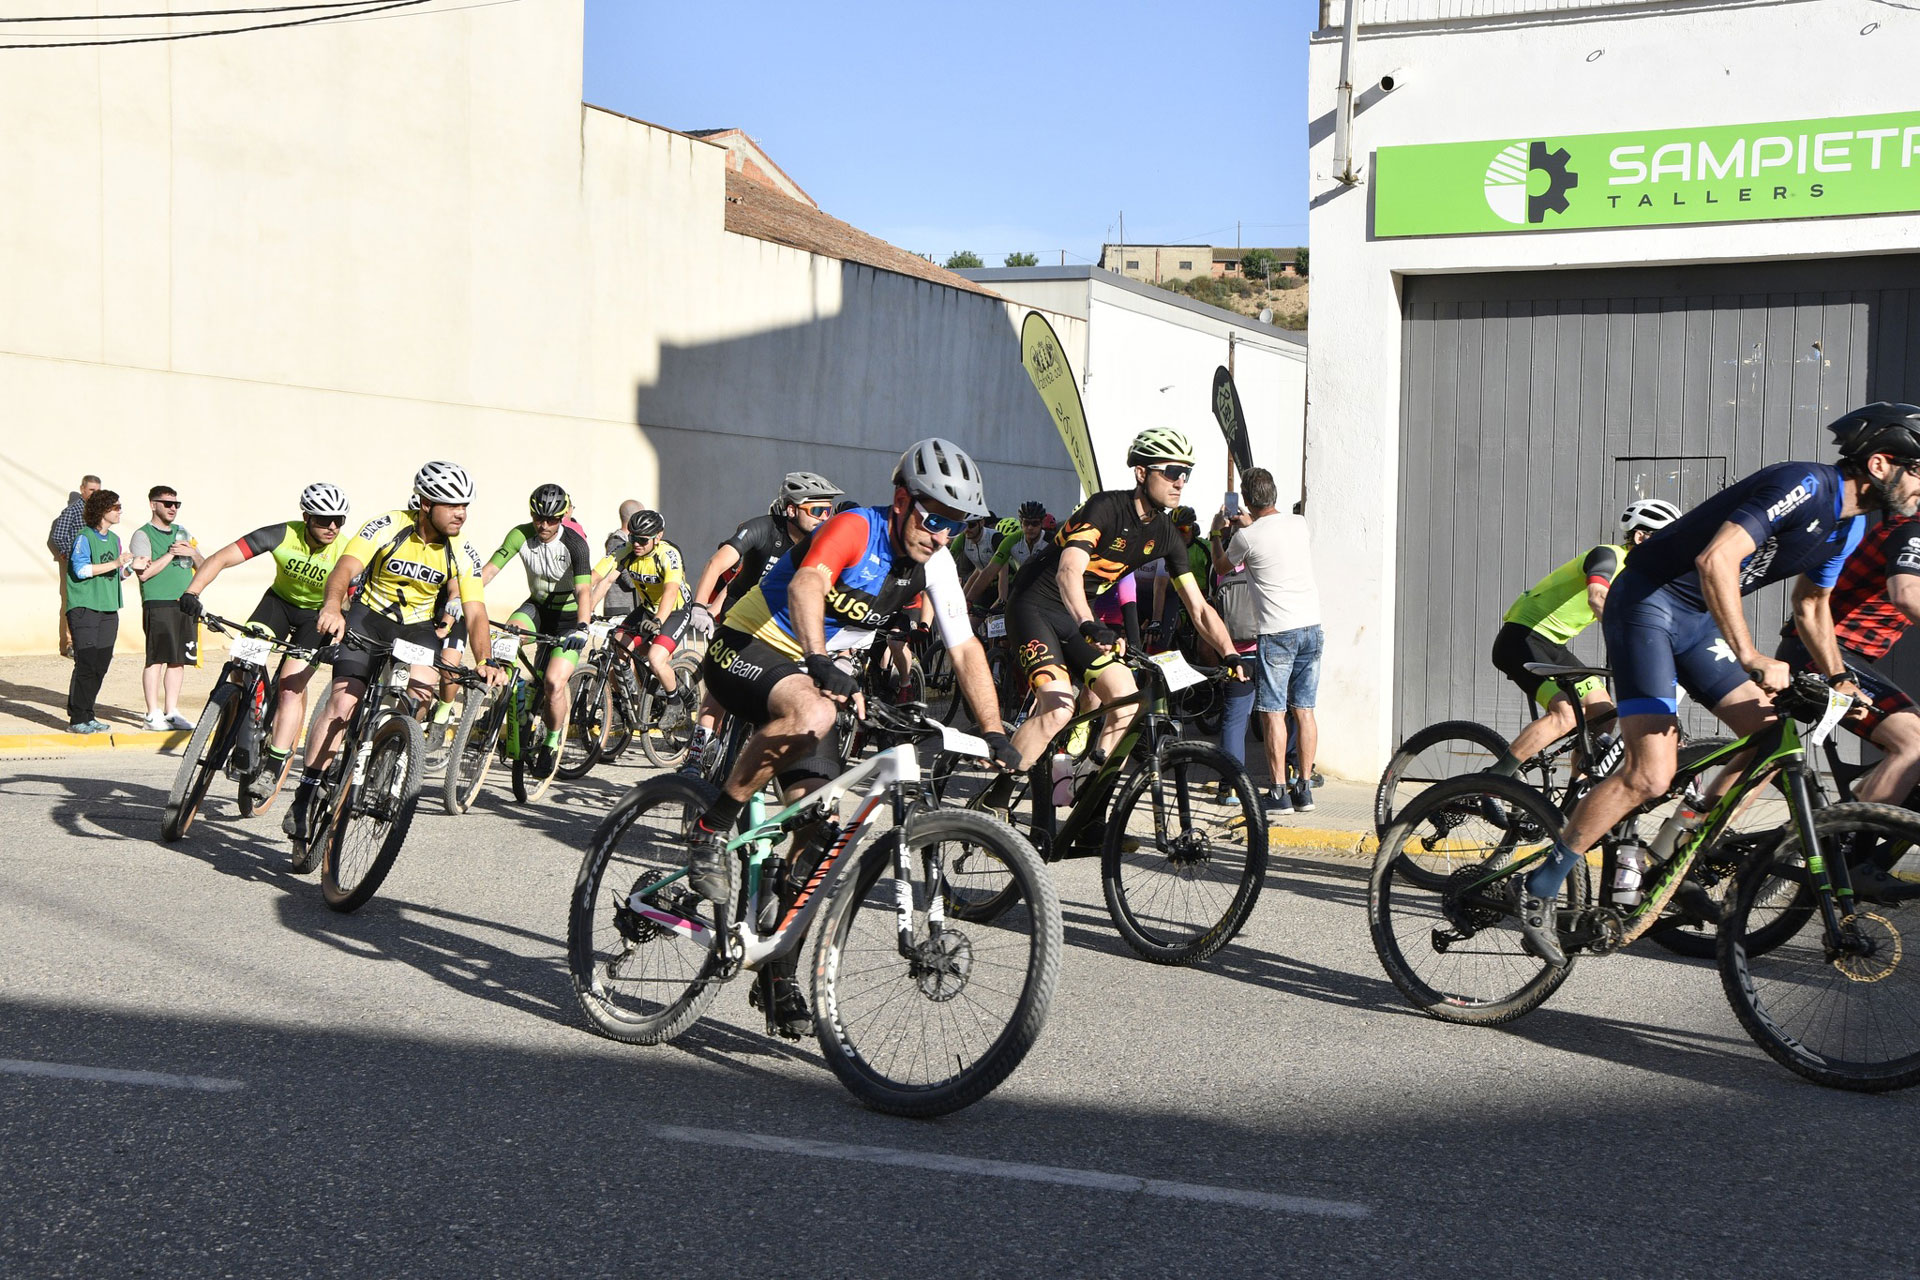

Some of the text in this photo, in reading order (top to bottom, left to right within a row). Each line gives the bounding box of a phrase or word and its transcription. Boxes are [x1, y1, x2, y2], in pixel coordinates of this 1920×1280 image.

[1607, 183, 1824, 208] TALLERS
[360, 515, 392, 540] ONCE
[386, 558, 446, 584] ONCE
